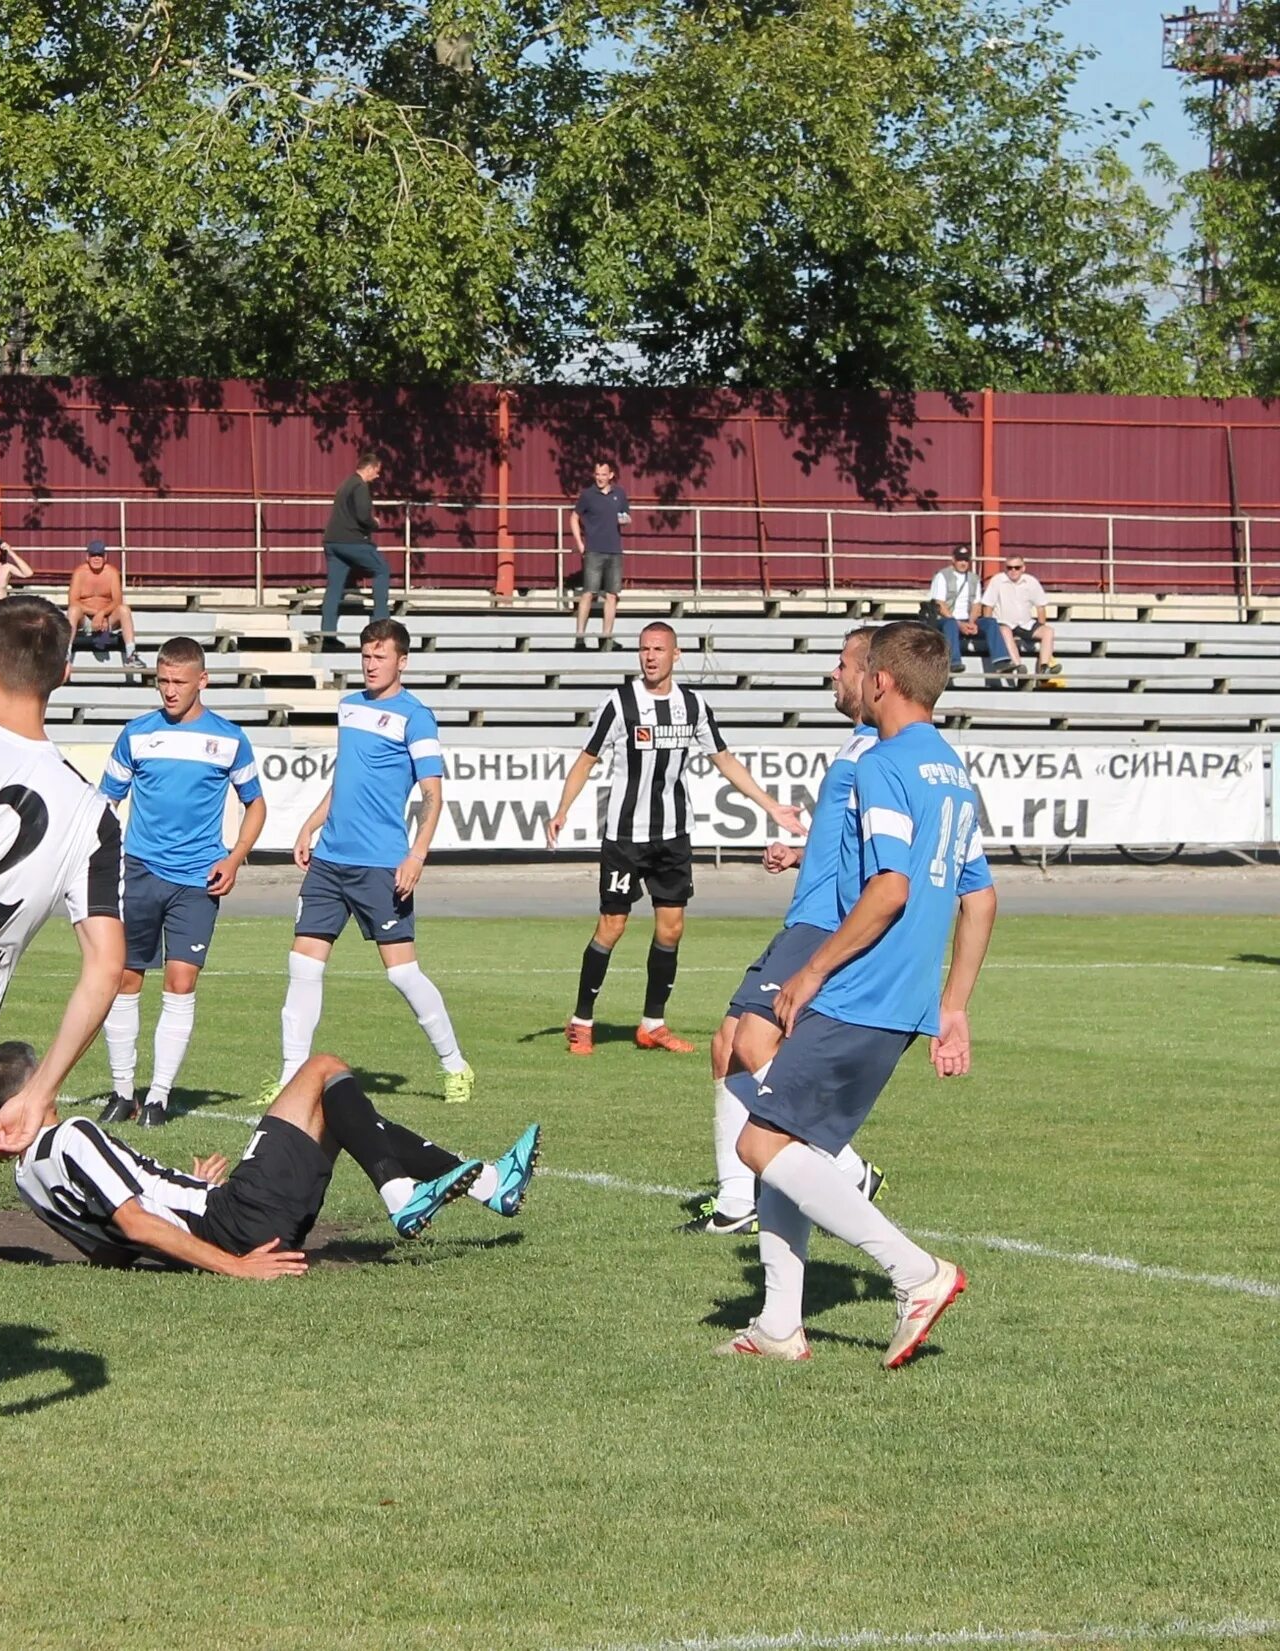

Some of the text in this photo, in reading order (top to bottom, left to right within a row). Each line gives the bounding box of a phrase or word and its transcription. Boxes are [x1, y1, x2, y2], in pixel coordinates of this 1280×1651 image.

[965, 751, 1082, 779] КЛУБА
[1095, 751, 1253, 780] «СИНАРА»
[607, 870, 631, 894] 14
